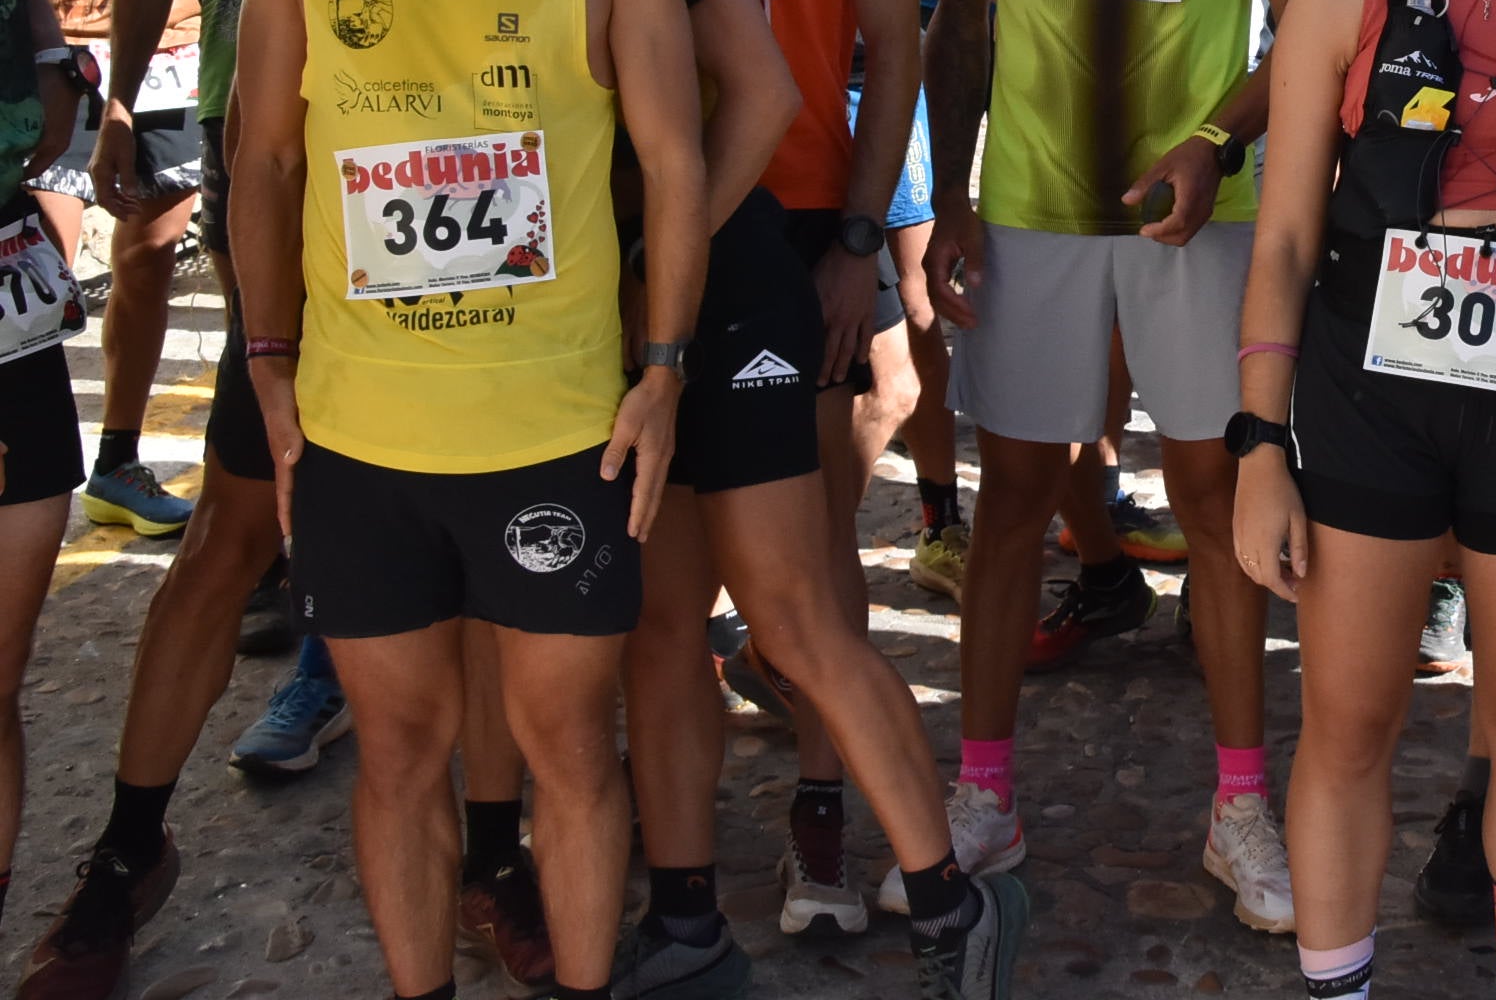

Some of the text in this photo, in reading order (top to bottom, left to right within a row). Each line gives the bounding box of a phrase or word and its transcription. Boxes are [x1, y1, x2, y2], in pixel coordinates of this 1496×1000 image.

[145, 64, 183, 92] 61
[363, 78, 435, 93] calcetines
[361, 93, 442, 120] ALARVI
[482, 107, 534, 122] montoya
[425, 140, 489, 154] FLORISTERÍAS
[343, 142, 541, 195] bedunia
[382, 189, 508, 256] 364
[0, 259, 57, 318] 70
[732, 379, 764, 390] NIKE
